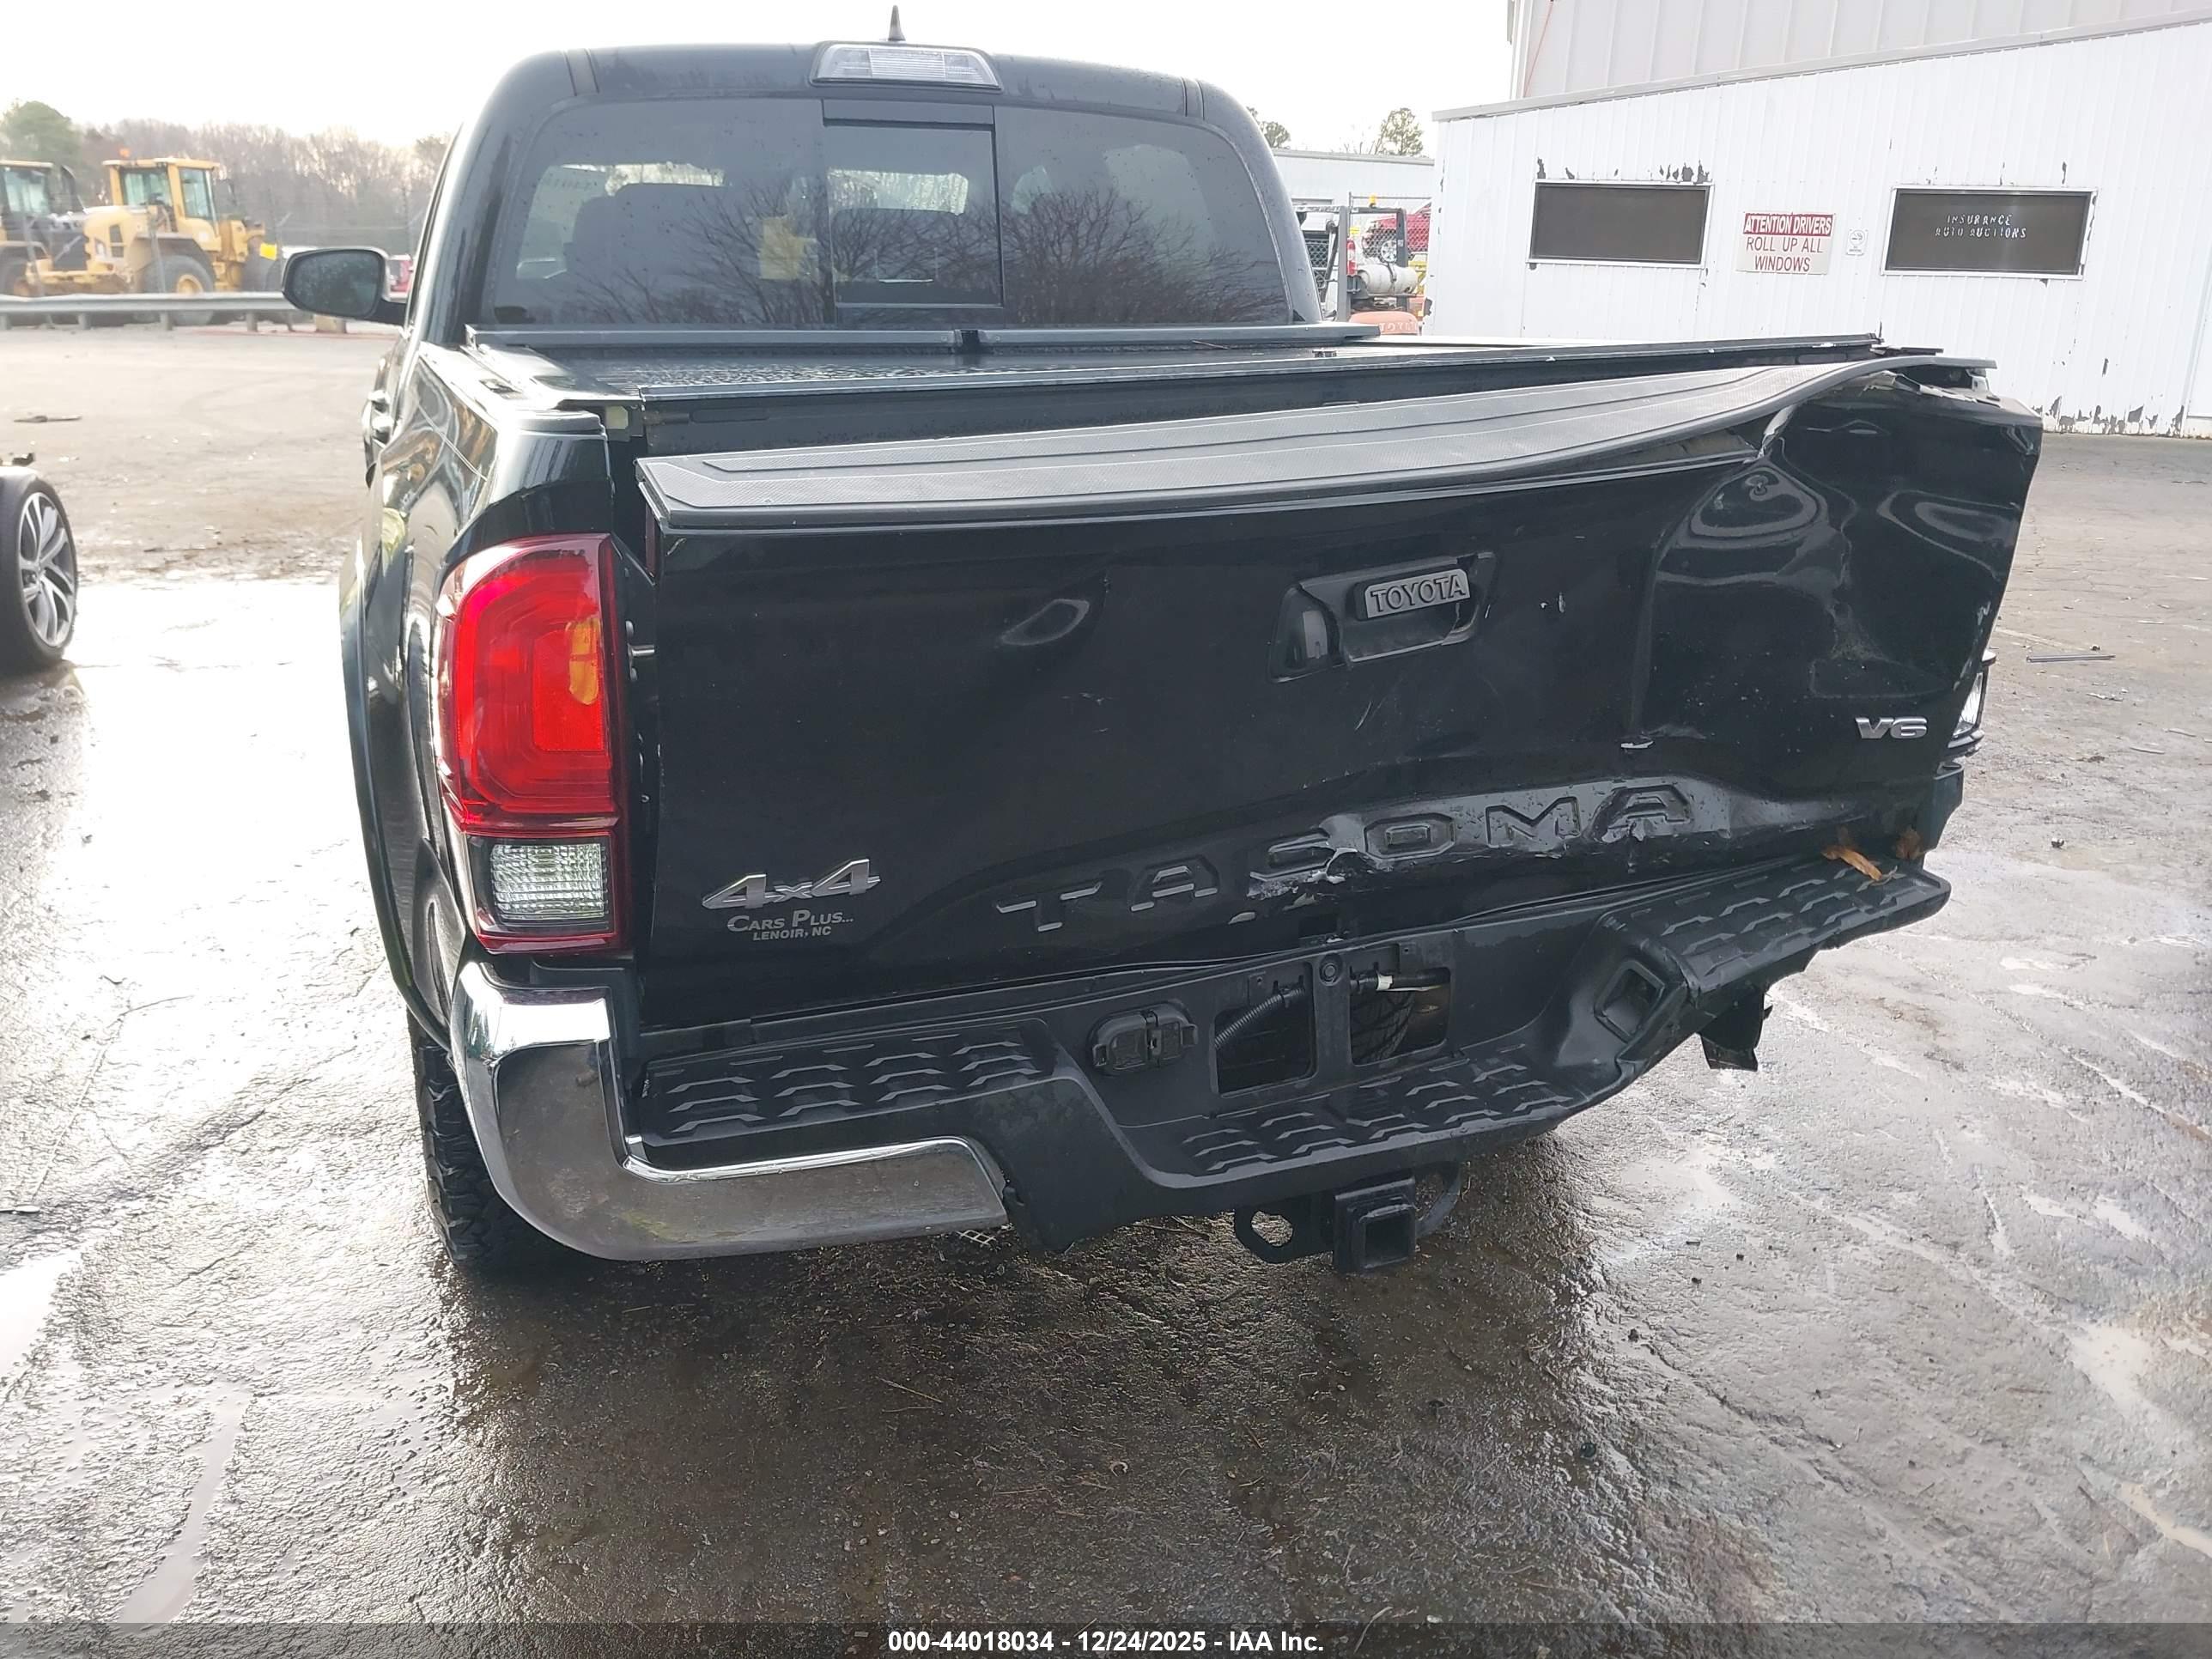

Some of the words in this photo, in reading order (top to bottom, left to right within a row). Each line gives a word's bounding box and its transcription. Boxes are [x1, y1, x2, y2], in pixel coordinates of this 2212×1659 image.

[1744, 215, 1792, 234] ATTENTION
[1793, 216, 1832, 235] DRIVERS
[1947, 215, 2013, 226] INSURANCE
[1746, 236, 1776, 252] ROLL
[1782, 236, 1798, 252] UP
[1801, 238, 1824, 253] ALL
[1754, 256, 1811, 272] WINDOWS
[1370, 574, 1466, 613] TOYOTA
[1855, 716, 1928, 739] V6
[994, 783, 1693, 932] TACOMA
[701, 858, 881, 909] 4x4
[727, 915, 785, 933] CARS
[752, 928, 808, 941] LENOIR,
[811, 926, 832, 937] NC
